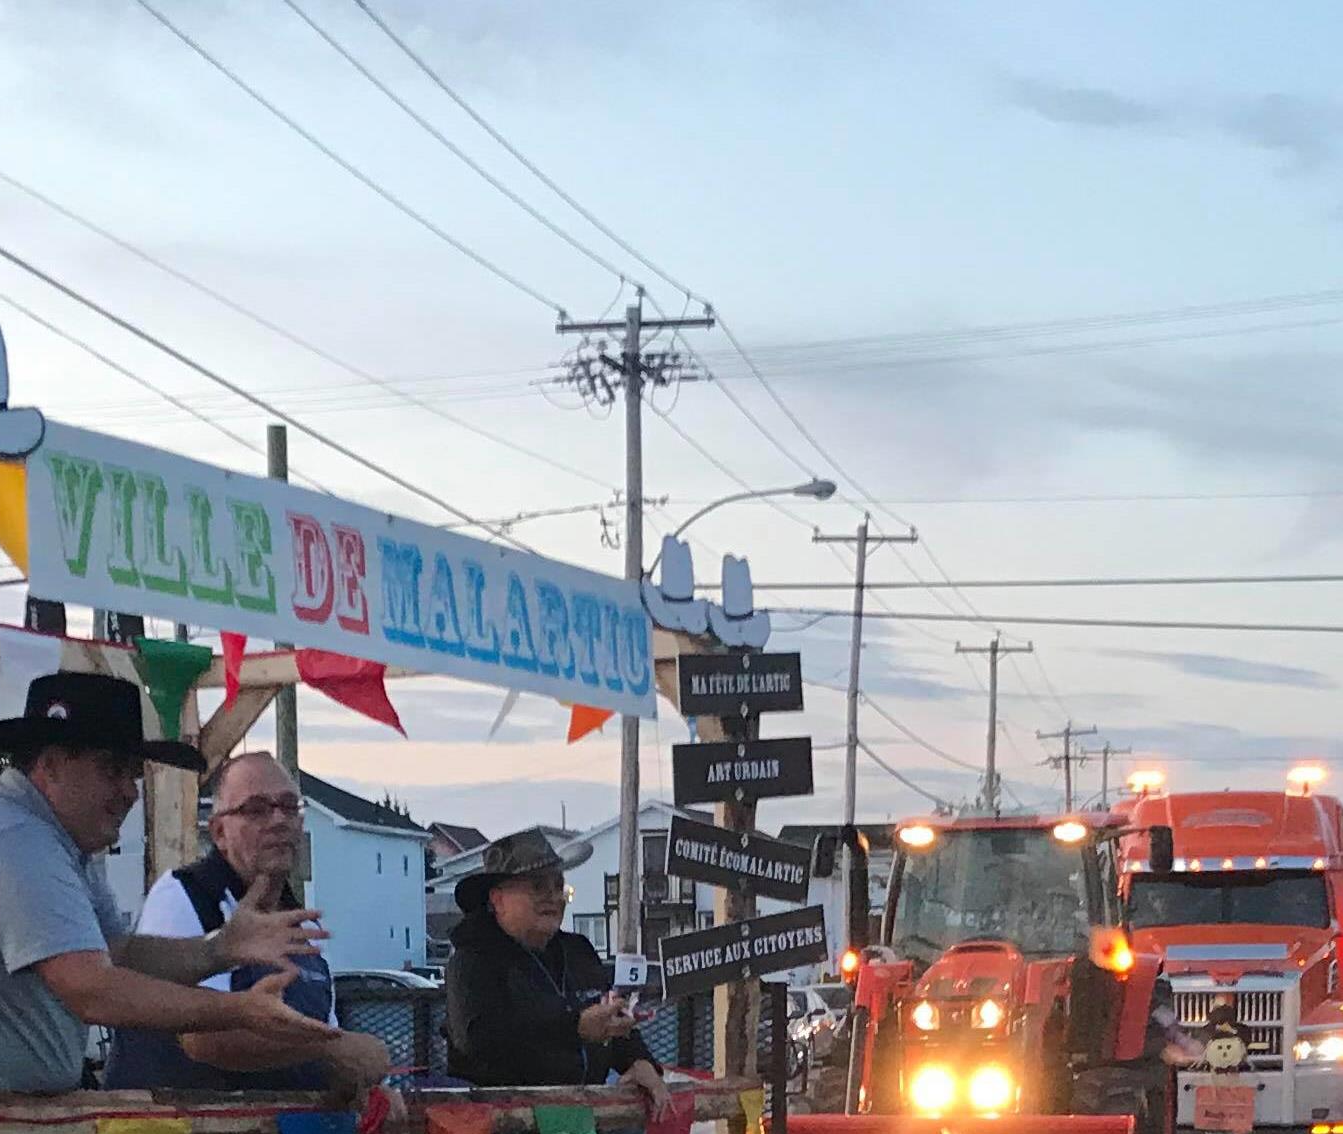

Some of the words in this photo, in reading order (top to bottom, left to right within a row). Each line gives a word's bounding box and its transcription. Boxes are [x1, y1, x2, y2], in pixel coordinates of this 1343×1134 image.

[47, 454, 276, 614] VILLE
[288, 513, 370, 635] DE
[379, 539, 651, 697] MALARTIC
[691, 674, 707, 695] MA
[736, 673, 751, 694] DE
[707, 762, 732, 783] ART
[734, 759, 779, 780] URBAIN
[675, 838, 718, 864] COMITÉ
[719, 846, 804, 884] ÉCOMALARTIC
[665, 948, 722, 977] SERVICE
[724, 939, 751, 964] AUX
[753, 926, 823, 955] CITOYENS
[629, 967, 639, 982] 5
